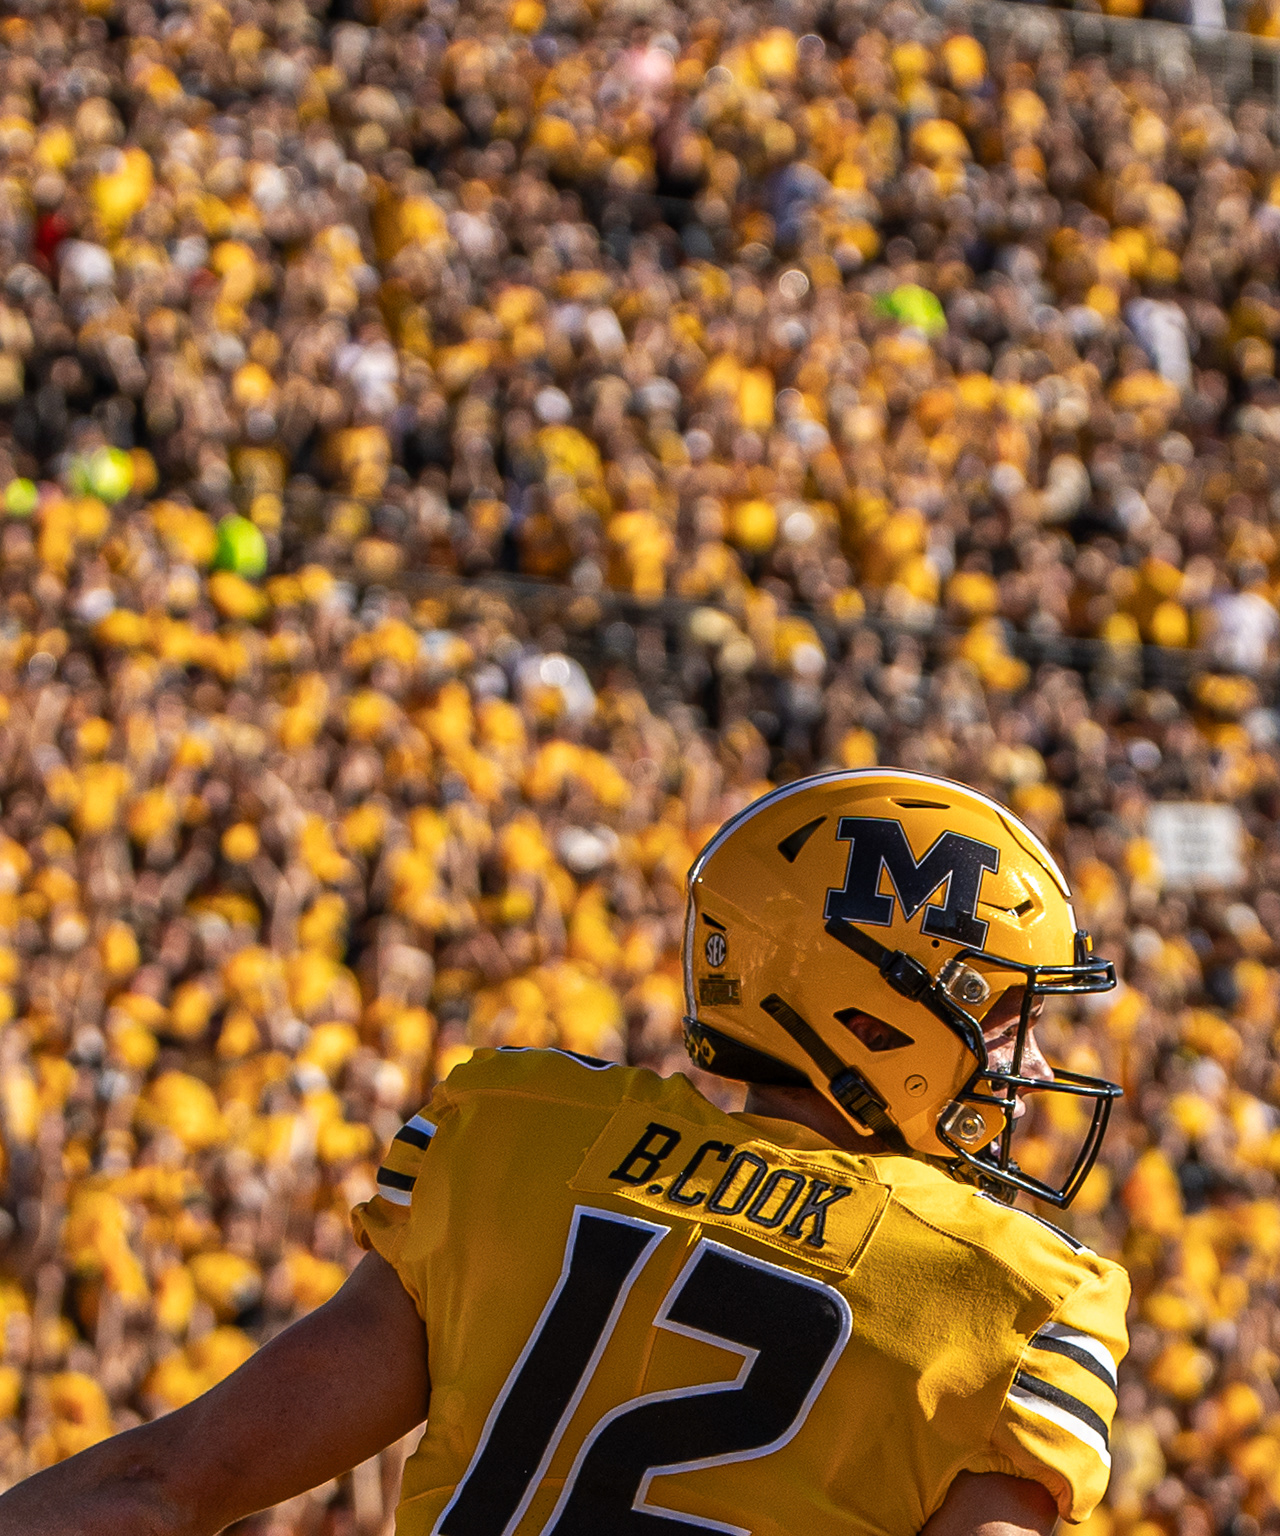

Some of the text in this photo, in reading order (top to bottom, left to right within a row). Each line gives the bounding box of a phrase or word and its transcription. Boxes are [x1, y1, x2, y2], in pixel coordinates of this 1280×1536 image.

[823, 816, 1000, 951] M
[707, 934, 726, 967] SEC
[608, 1121, 853, 1248] B.COOK
